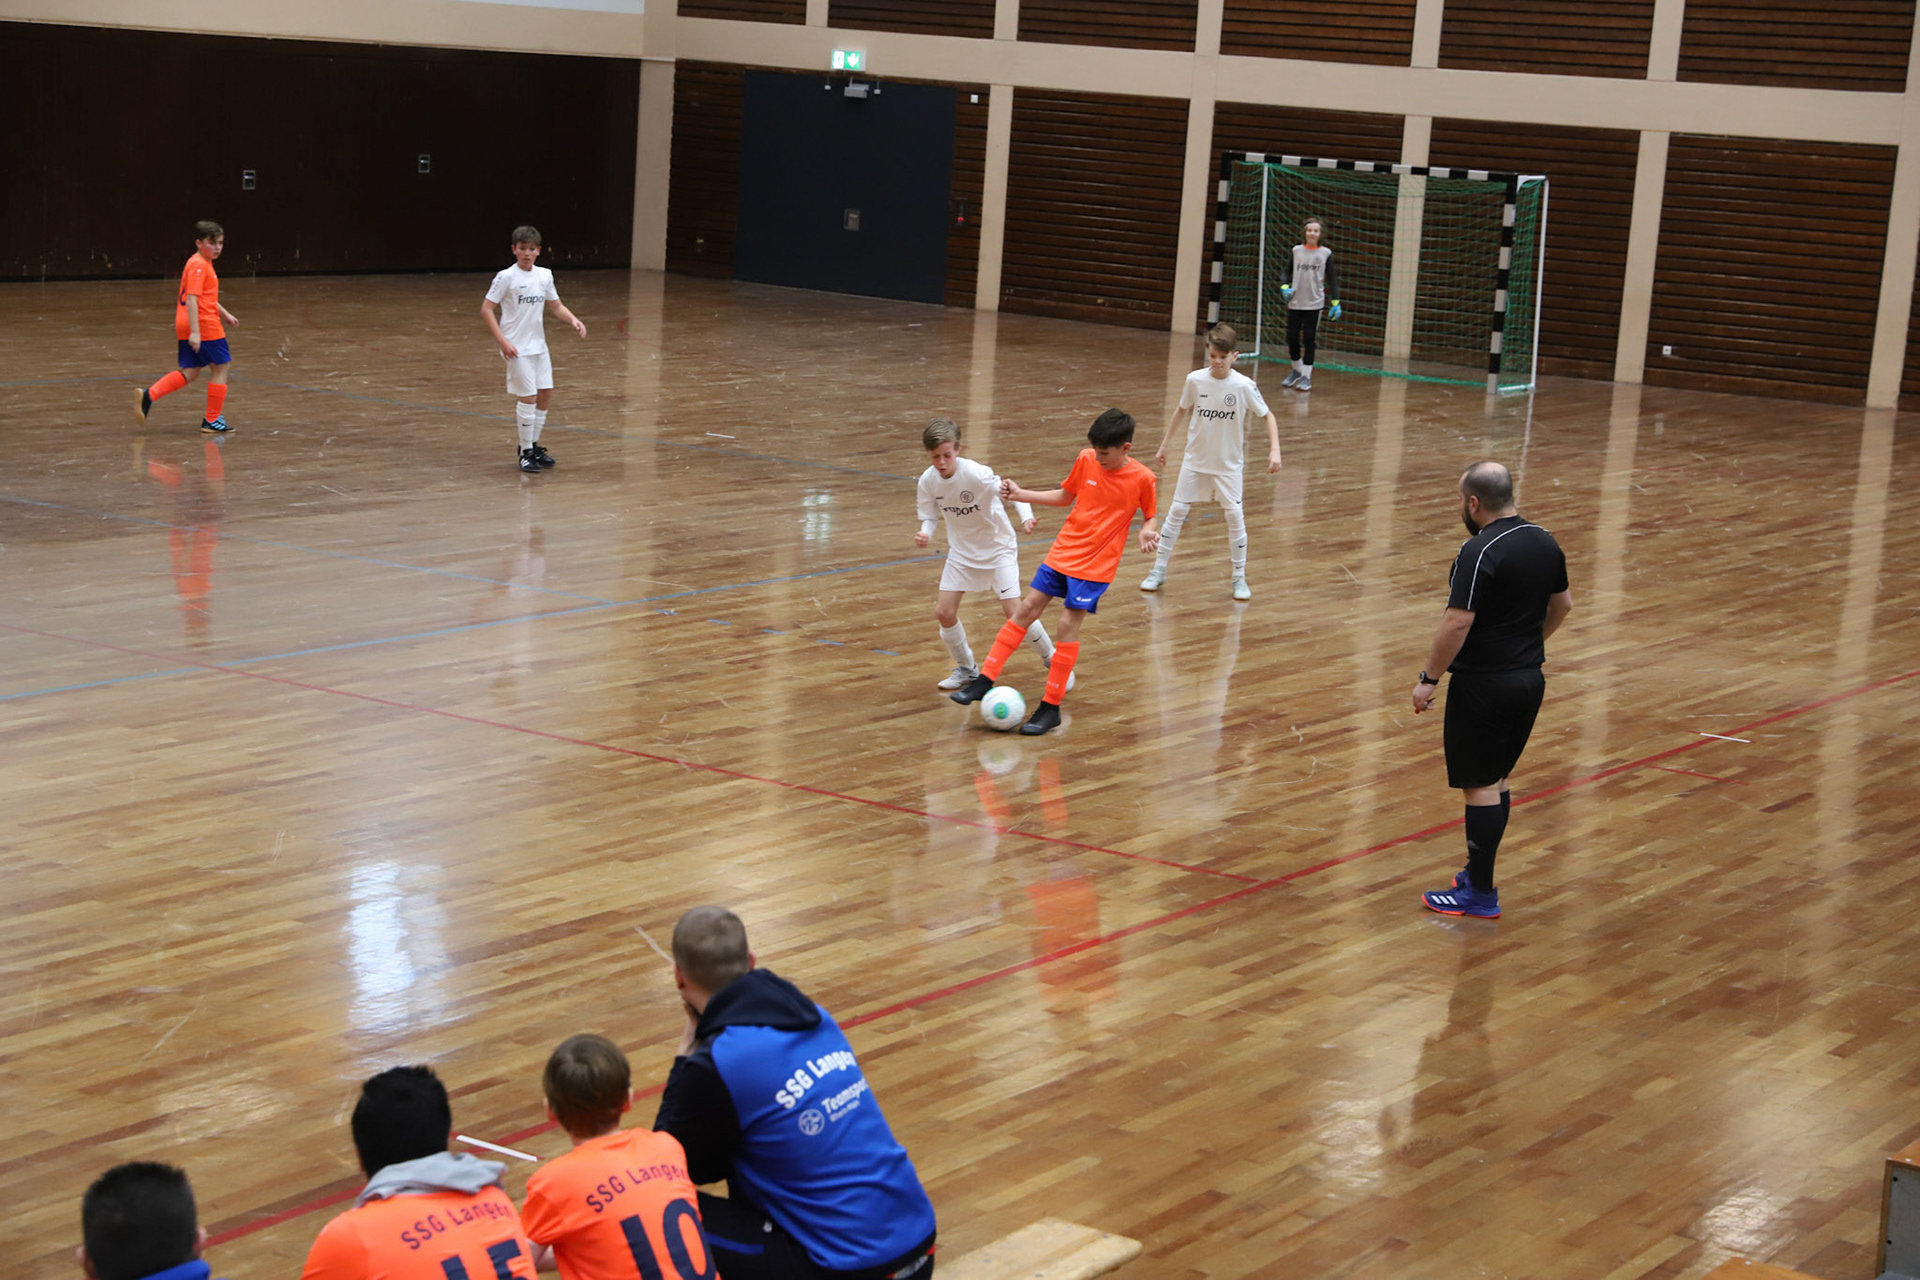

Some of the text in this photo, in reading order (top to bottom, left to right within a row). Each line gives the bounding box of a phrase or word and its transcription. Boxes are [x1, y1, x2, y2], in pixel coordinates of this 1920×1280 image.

[939, 504, 981, 517] raport
[775, 1069, 814, 1109] SSG
[586, 1175, 626, 1213] SSG
[401, 1214, 446, 1250] SSG
[620, 1198, 717, 1280] 10
